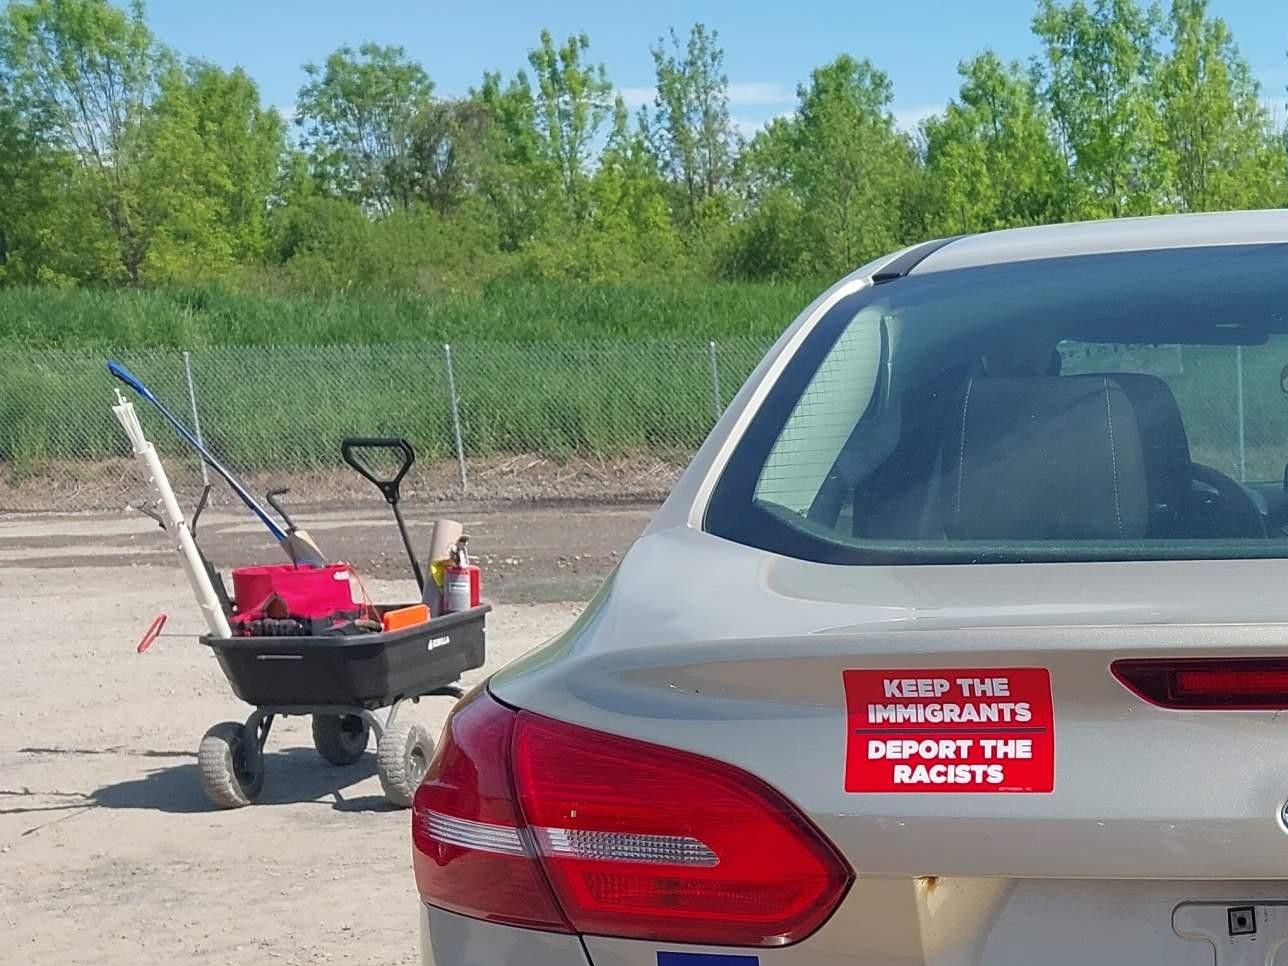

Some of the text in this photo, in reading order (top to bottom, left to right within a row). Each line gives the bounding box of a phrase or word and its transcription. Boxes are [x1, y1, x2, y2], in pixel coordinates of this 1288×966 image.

[883, 677, 1010, 698] KEEP THE
[867, 702, 1032, 723] IMMIGRANTS
[867, 739, 1033, 760] DEPORT THE
[893, 764, 1005, 784] RACISTS
